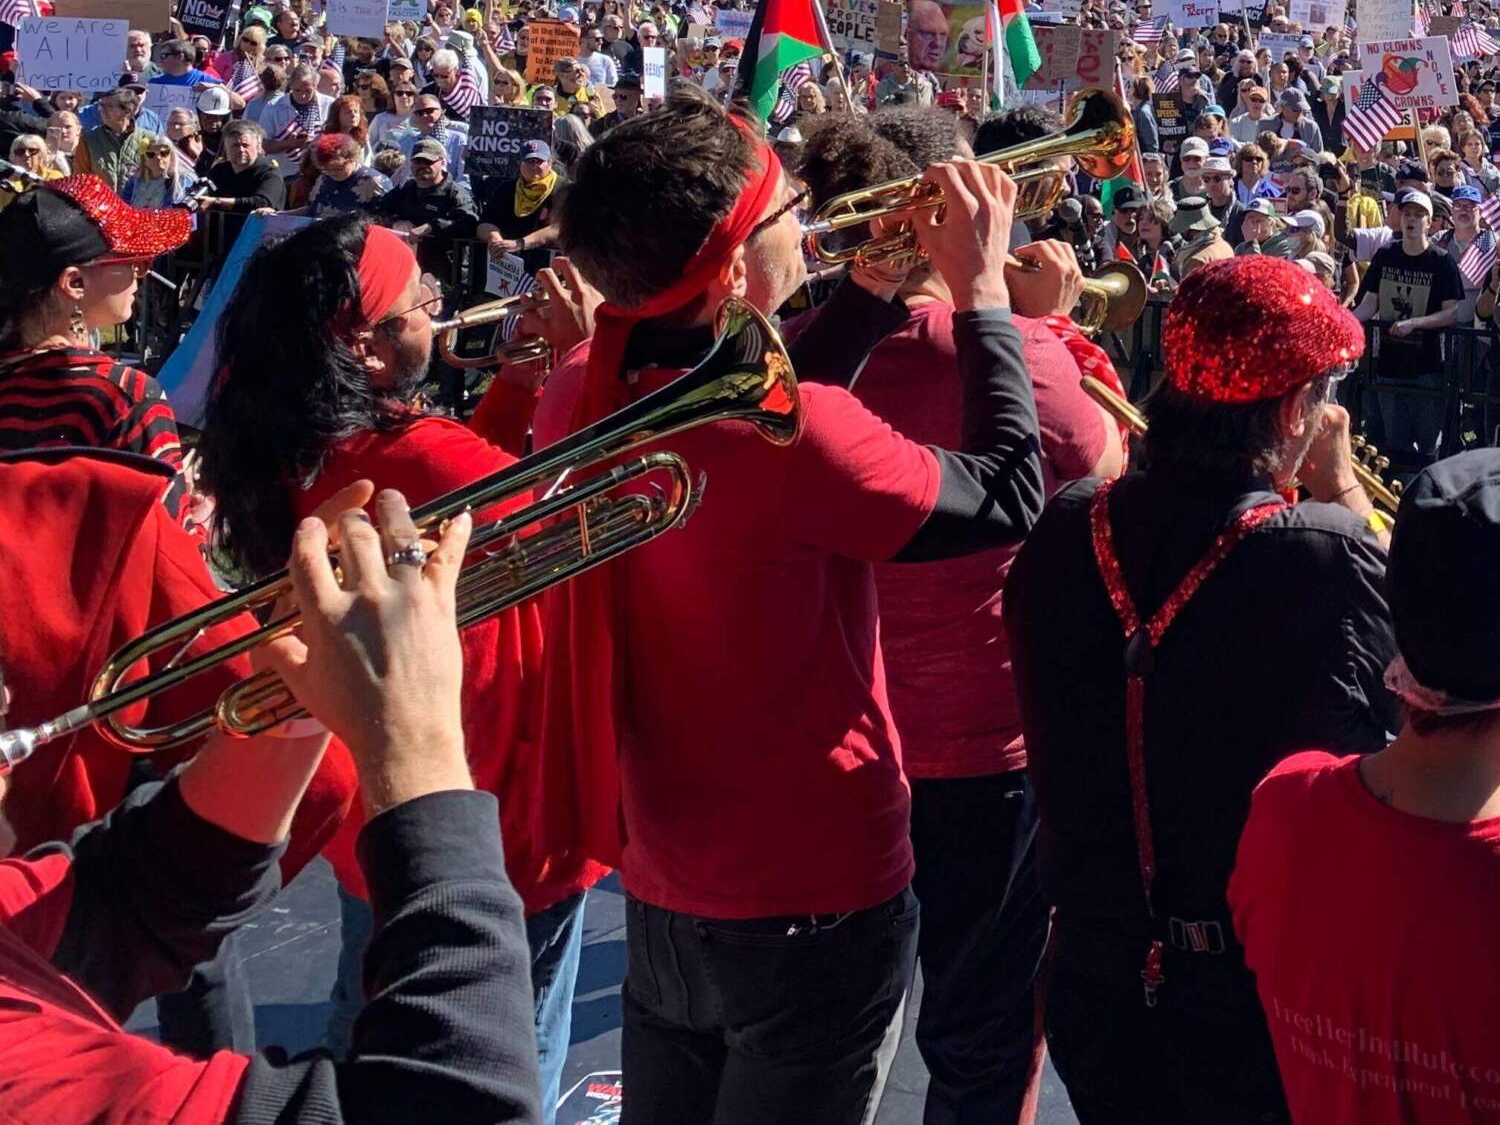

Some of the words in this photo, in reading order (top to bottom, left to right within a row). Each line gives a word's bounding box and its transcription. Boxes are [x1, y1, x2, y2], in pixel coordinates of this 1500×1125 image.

[184, 0, 206, 17] NO
[24, 20, 61, 35] We
[75, 20, 120, 37] Are
[36, 37, 89, 62] All
[1367, 43, 1379, 55] NO
[1383, 40, 1423, 53] CLOWNS
[1159, 100, 1175, 109] FREE
[1394, 95, 1434, 108] CROWNS
[481, 119, 509, 136] NO
[1158, 126, 1186, 135] COUNTRY
[1161, 118, 1177, 127] FREE
[468, 135, 521, 154] KINGS
